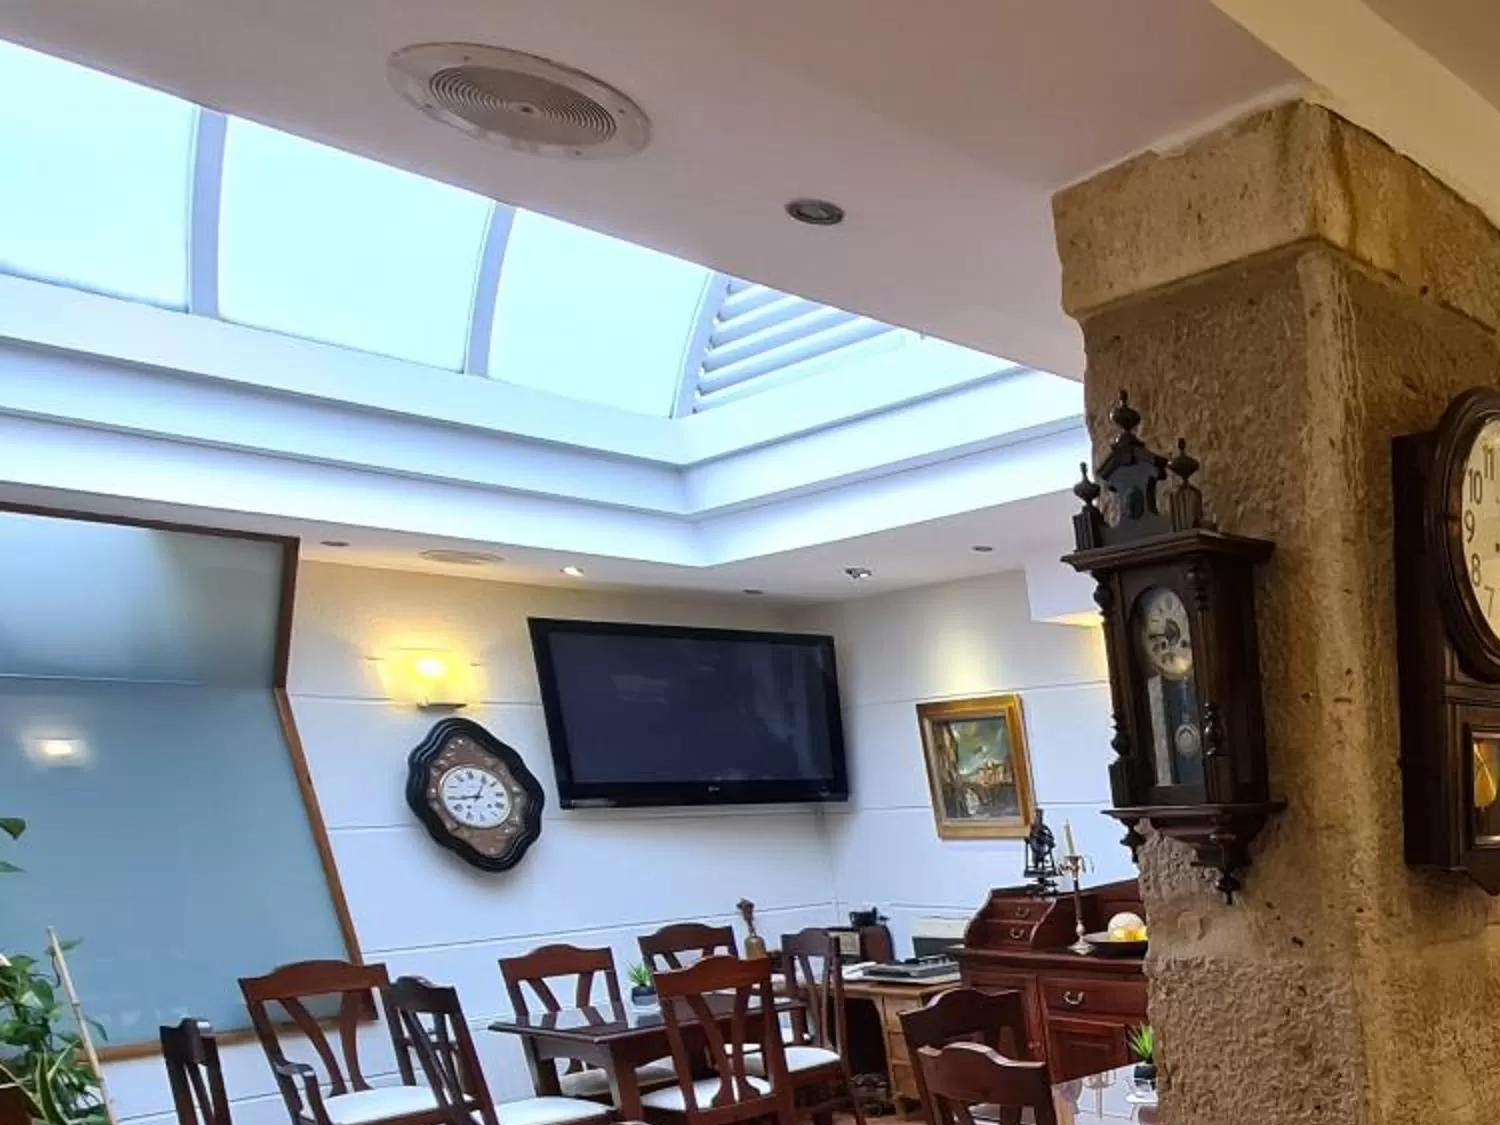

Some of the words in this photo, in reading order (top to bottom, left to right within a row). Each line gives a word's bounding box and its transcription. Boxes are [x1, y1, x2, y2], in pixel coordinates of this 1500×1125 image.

[1483, 444, 1495, 480] 11
[1467, 468, 1483, 505] 10
[1464, 509, 1476, 544] 9
[1471, 552, 1481, 588] 8
[1483, 585, 1496, 619] 7
